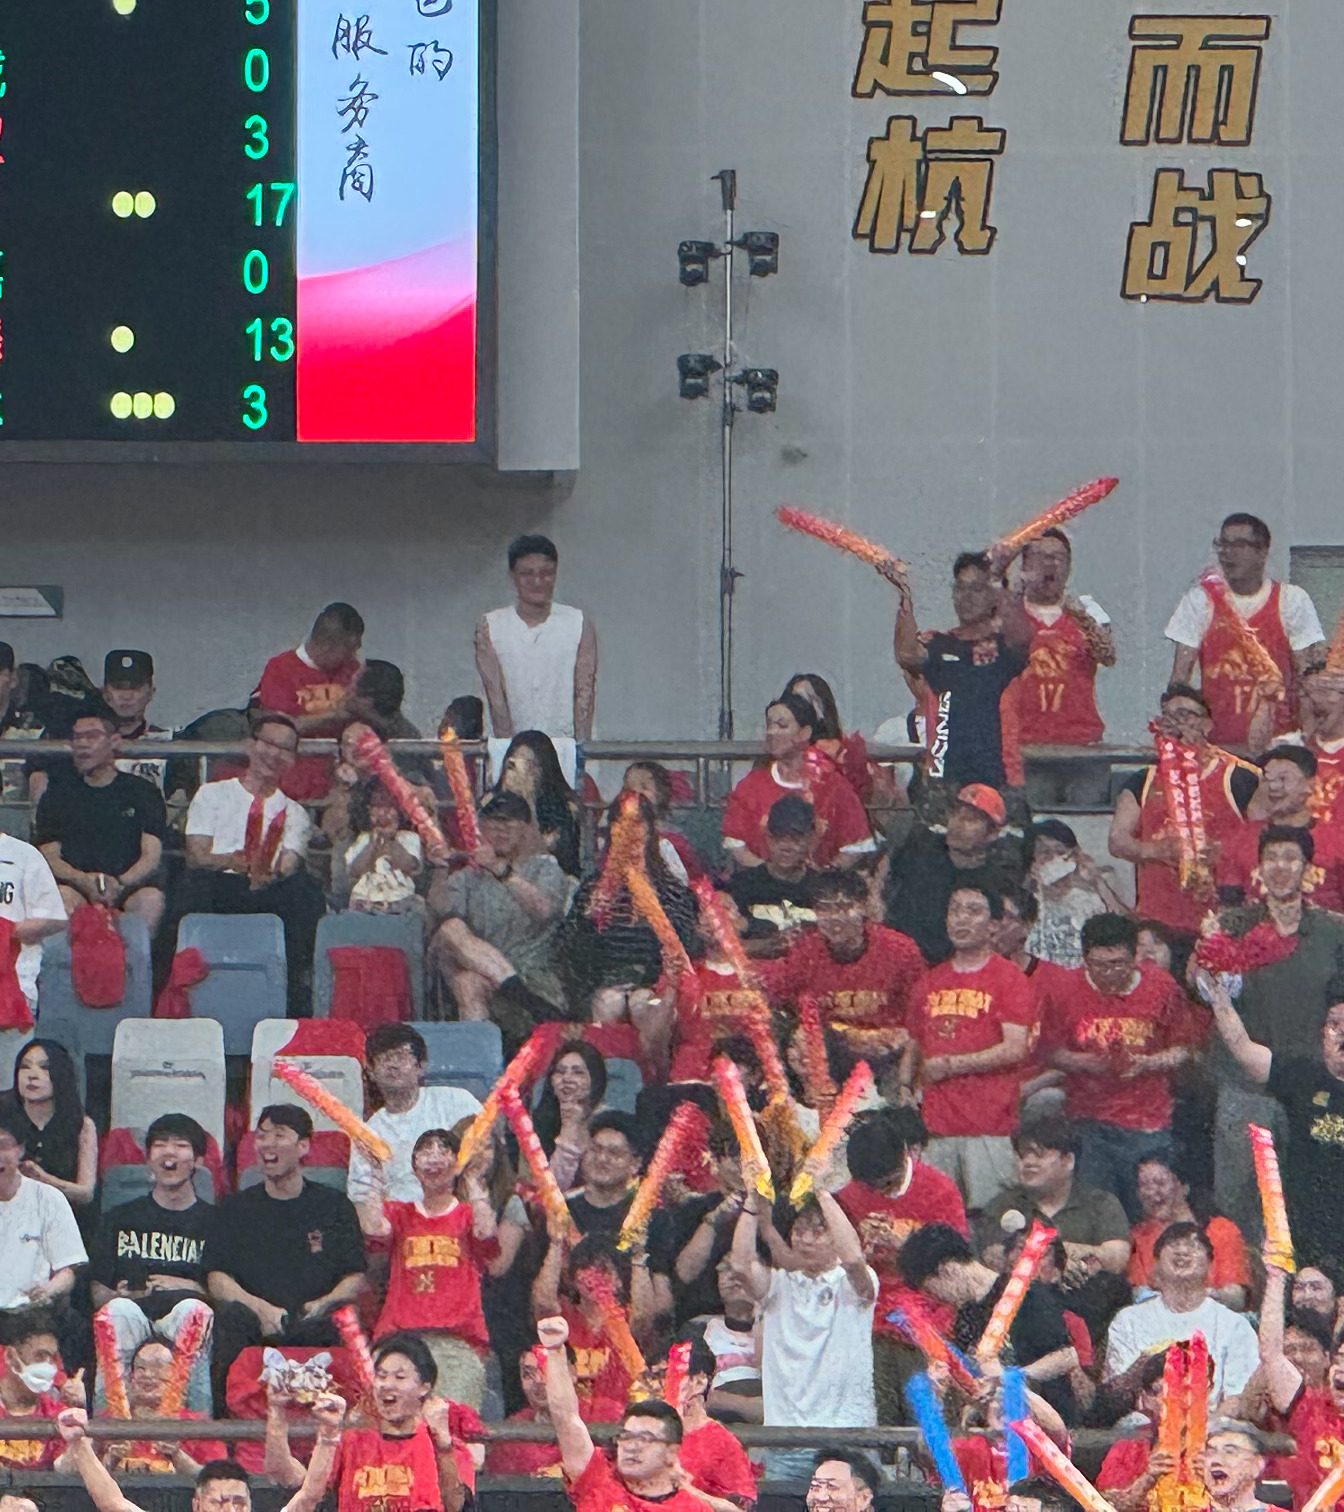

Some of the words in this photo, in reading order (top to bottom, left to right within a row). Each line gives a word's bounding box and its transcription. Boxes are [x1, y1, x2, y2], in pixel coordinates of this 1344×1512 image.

[245, 48, 270, 92] 0
[244, 115, 268, 159] 3
[246, 181, 296, 227] 17
[242, 250, 267, 294] 0
[246, 317, 294, 362] 13
[243, 384, 267, 429] 3
